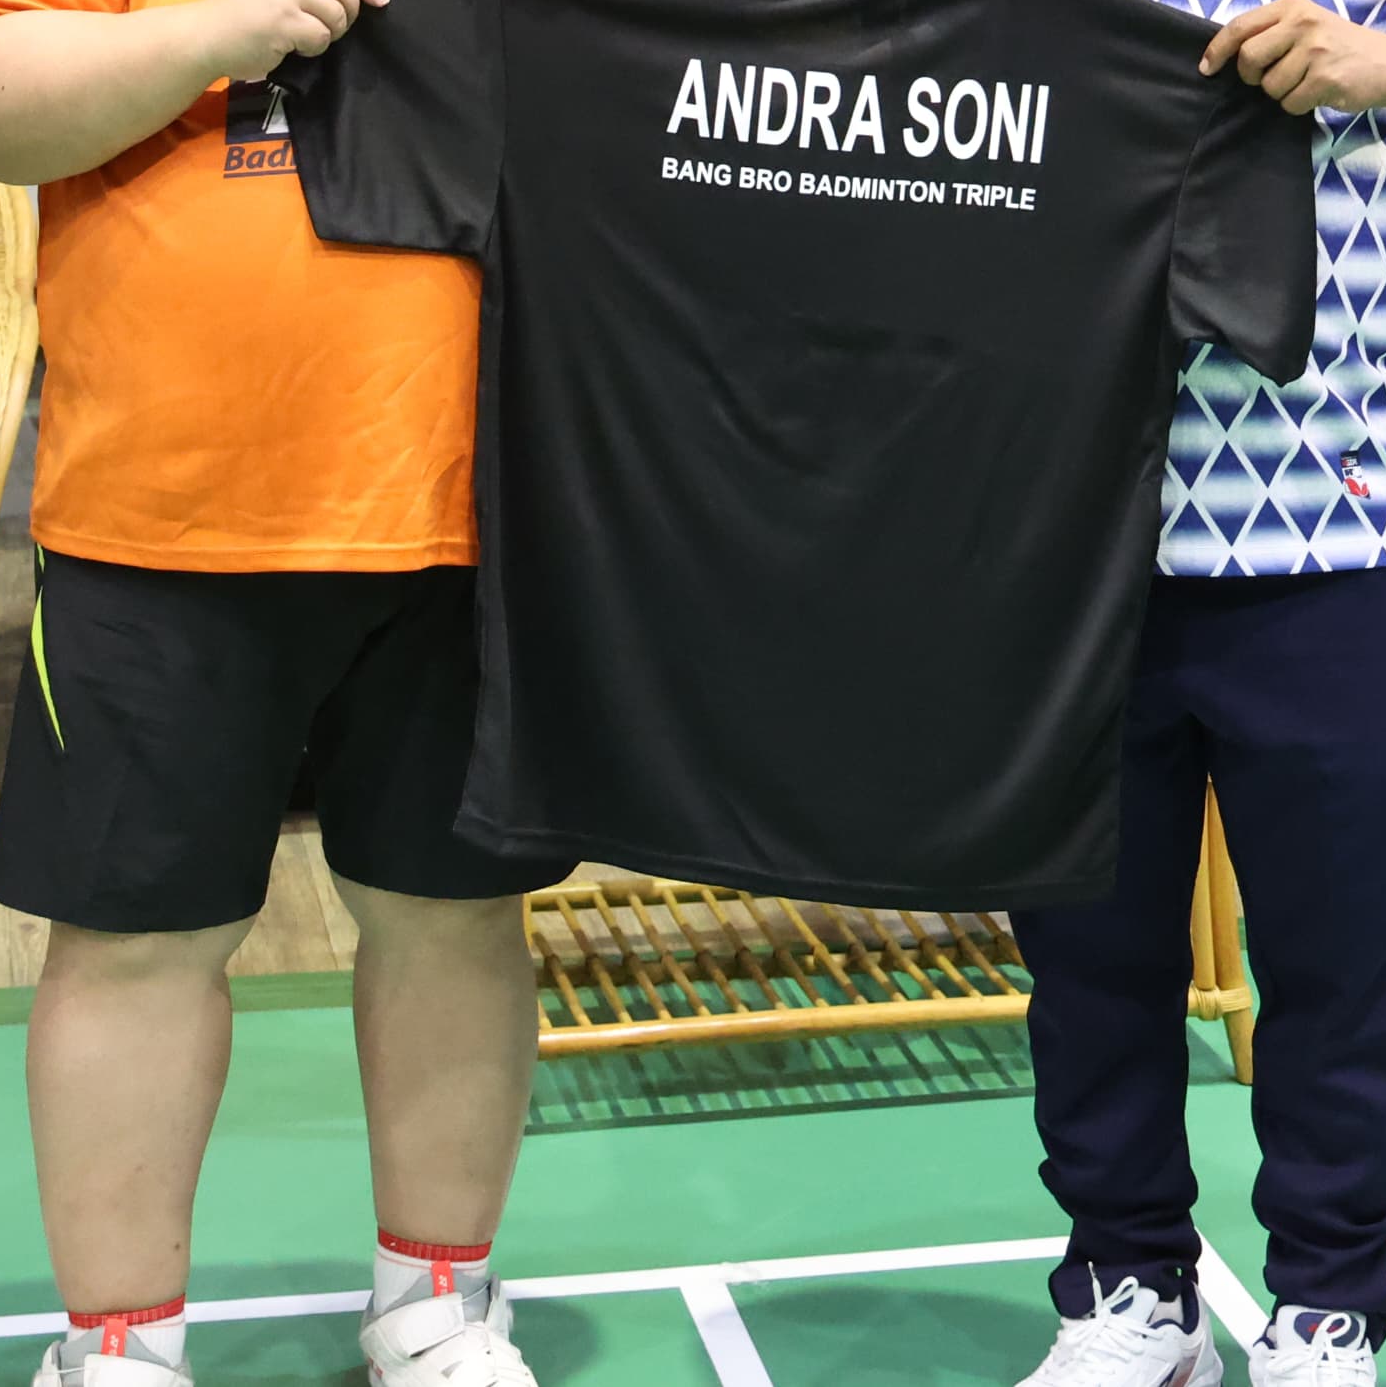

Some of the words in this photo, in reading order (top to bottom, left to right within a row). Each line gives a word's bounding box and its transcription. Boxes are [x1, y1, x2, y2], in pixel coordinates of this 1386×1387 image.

[667, 58, 886, 154] ANDRA
[903, 76, 1050, 164] SONI
[662, 157, 732, 187] BANG
[739, 166, 792, 193] BRO
[799, 172, 945, 204] BADMINTON
[953, 182, 1036, 211] TRIPLE
